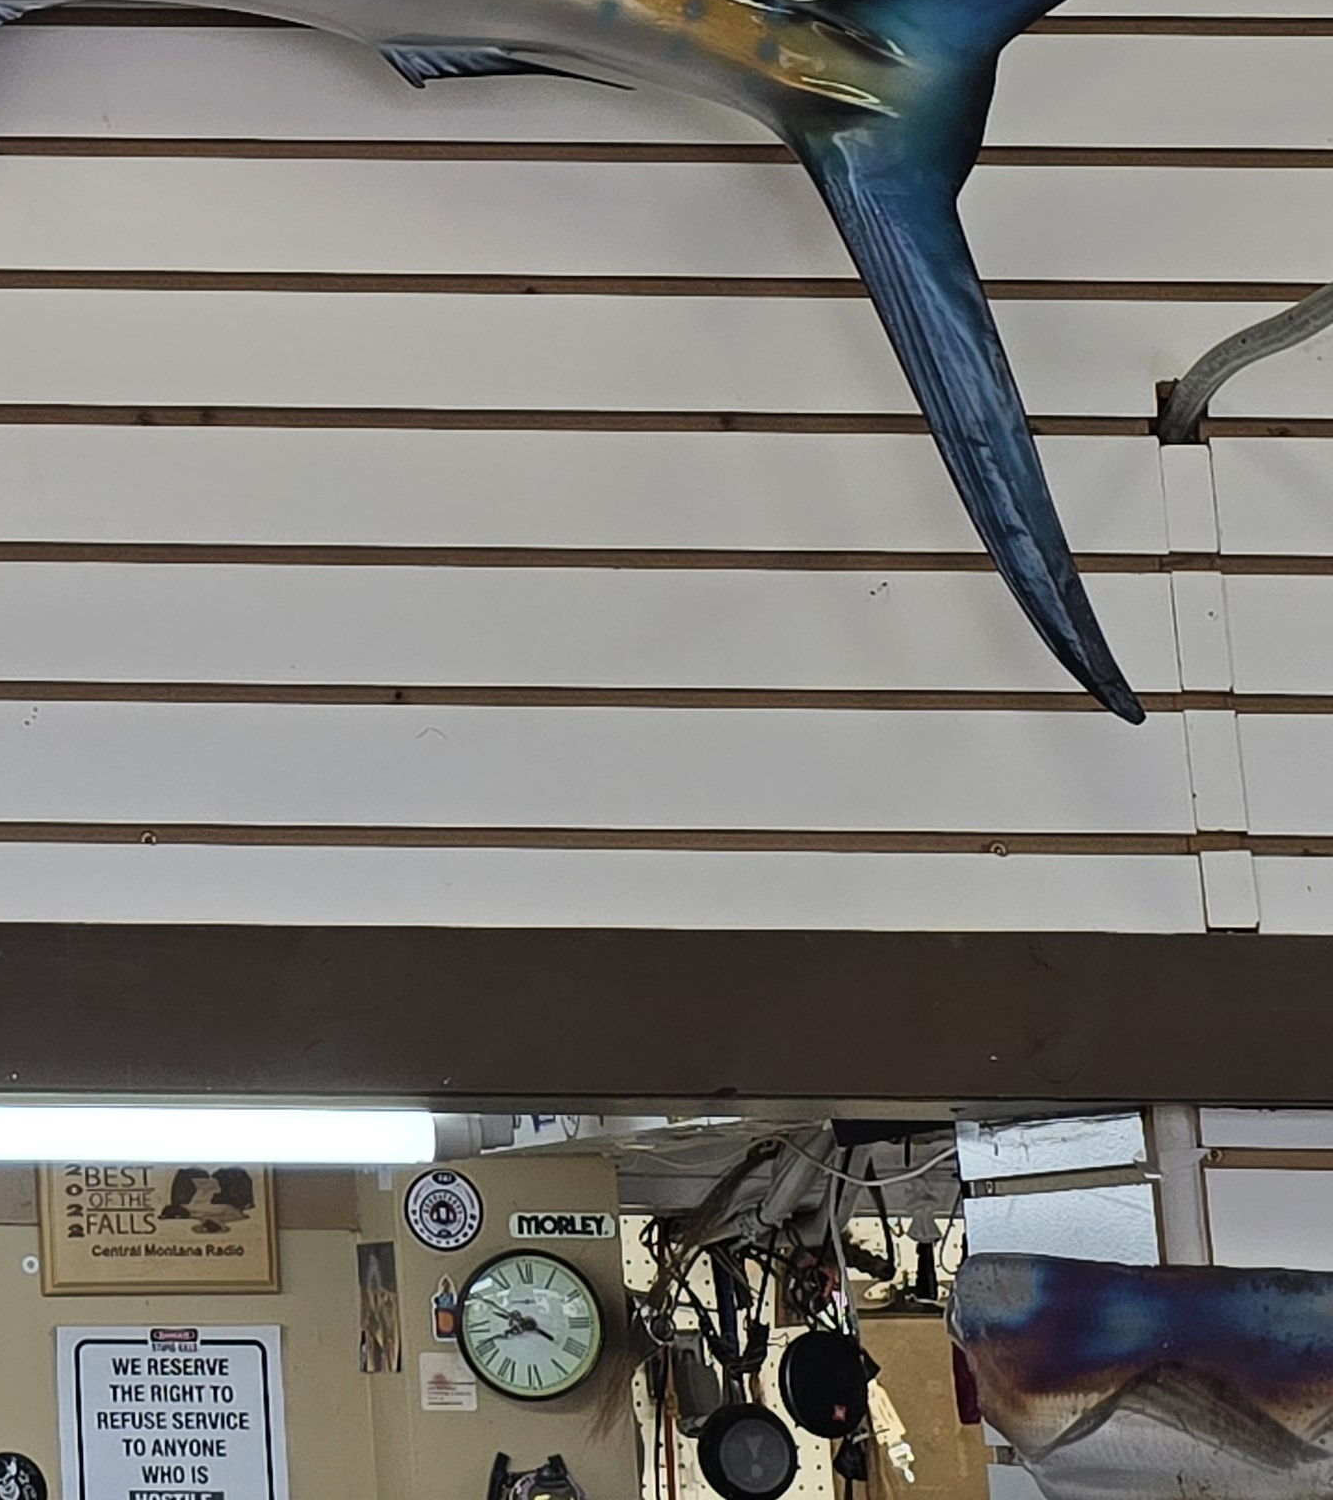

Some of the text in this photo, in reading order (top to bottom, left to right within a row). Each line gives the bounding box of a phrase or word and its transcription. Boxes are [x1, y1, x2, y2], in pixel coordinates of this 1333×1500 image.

[84, 1166, 154, 1188] BEST
[88, 1192, 153, 1208] OF THE
[85, 1213, 157, 1235] FALLS
[92, 1243, 245, 1258] Central Montana Radio
[112, 1357, 230, 1376] WE RESERVE
[109, 1384, 234, 1403] THE RIGHT TO
[96, 1411, 251, 1430] REFUSE SERVICE
[122, 1438, 228, 1457] TO ANYONE
[141, 1465, 210, 1484] WHO IS
